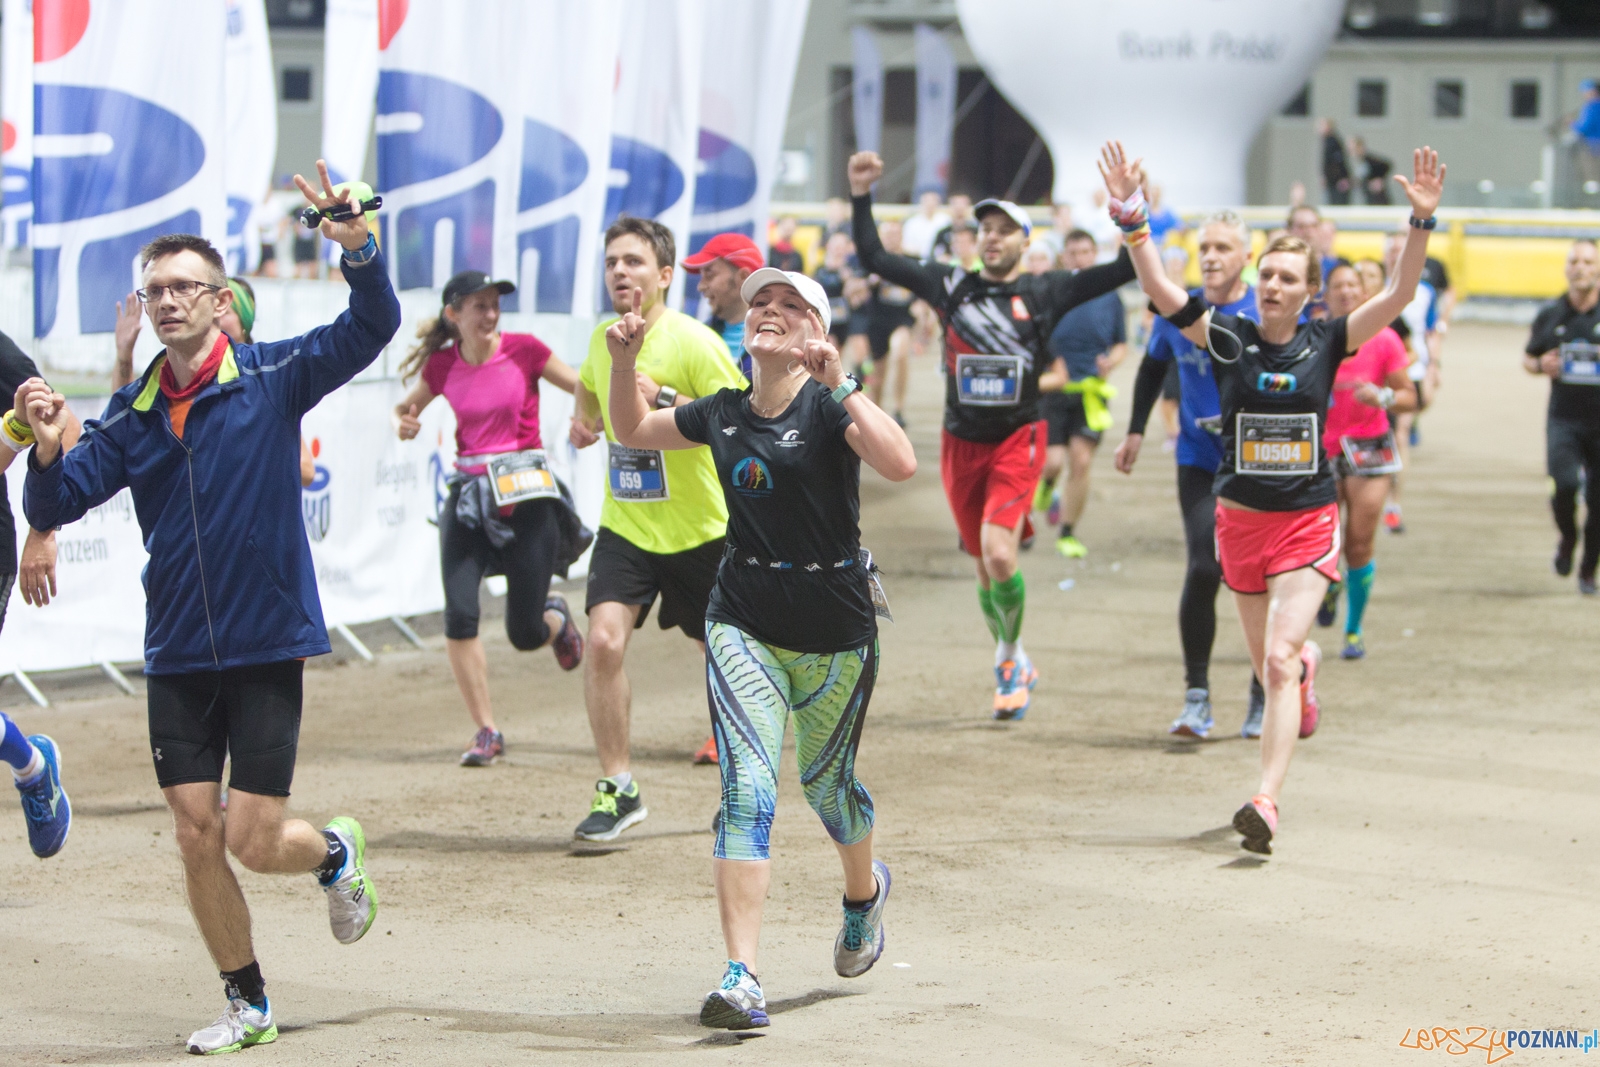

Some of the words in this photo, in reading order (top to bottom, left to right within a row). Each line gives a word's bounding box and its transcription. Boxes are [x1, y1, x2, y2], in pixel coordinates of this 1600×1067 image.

[1253, 443, 1301, 461] 10504
[619, 471, 643, 489] 659
[57, 537, 108, 564] razem
[769, 561, 793, 570] sailfish
